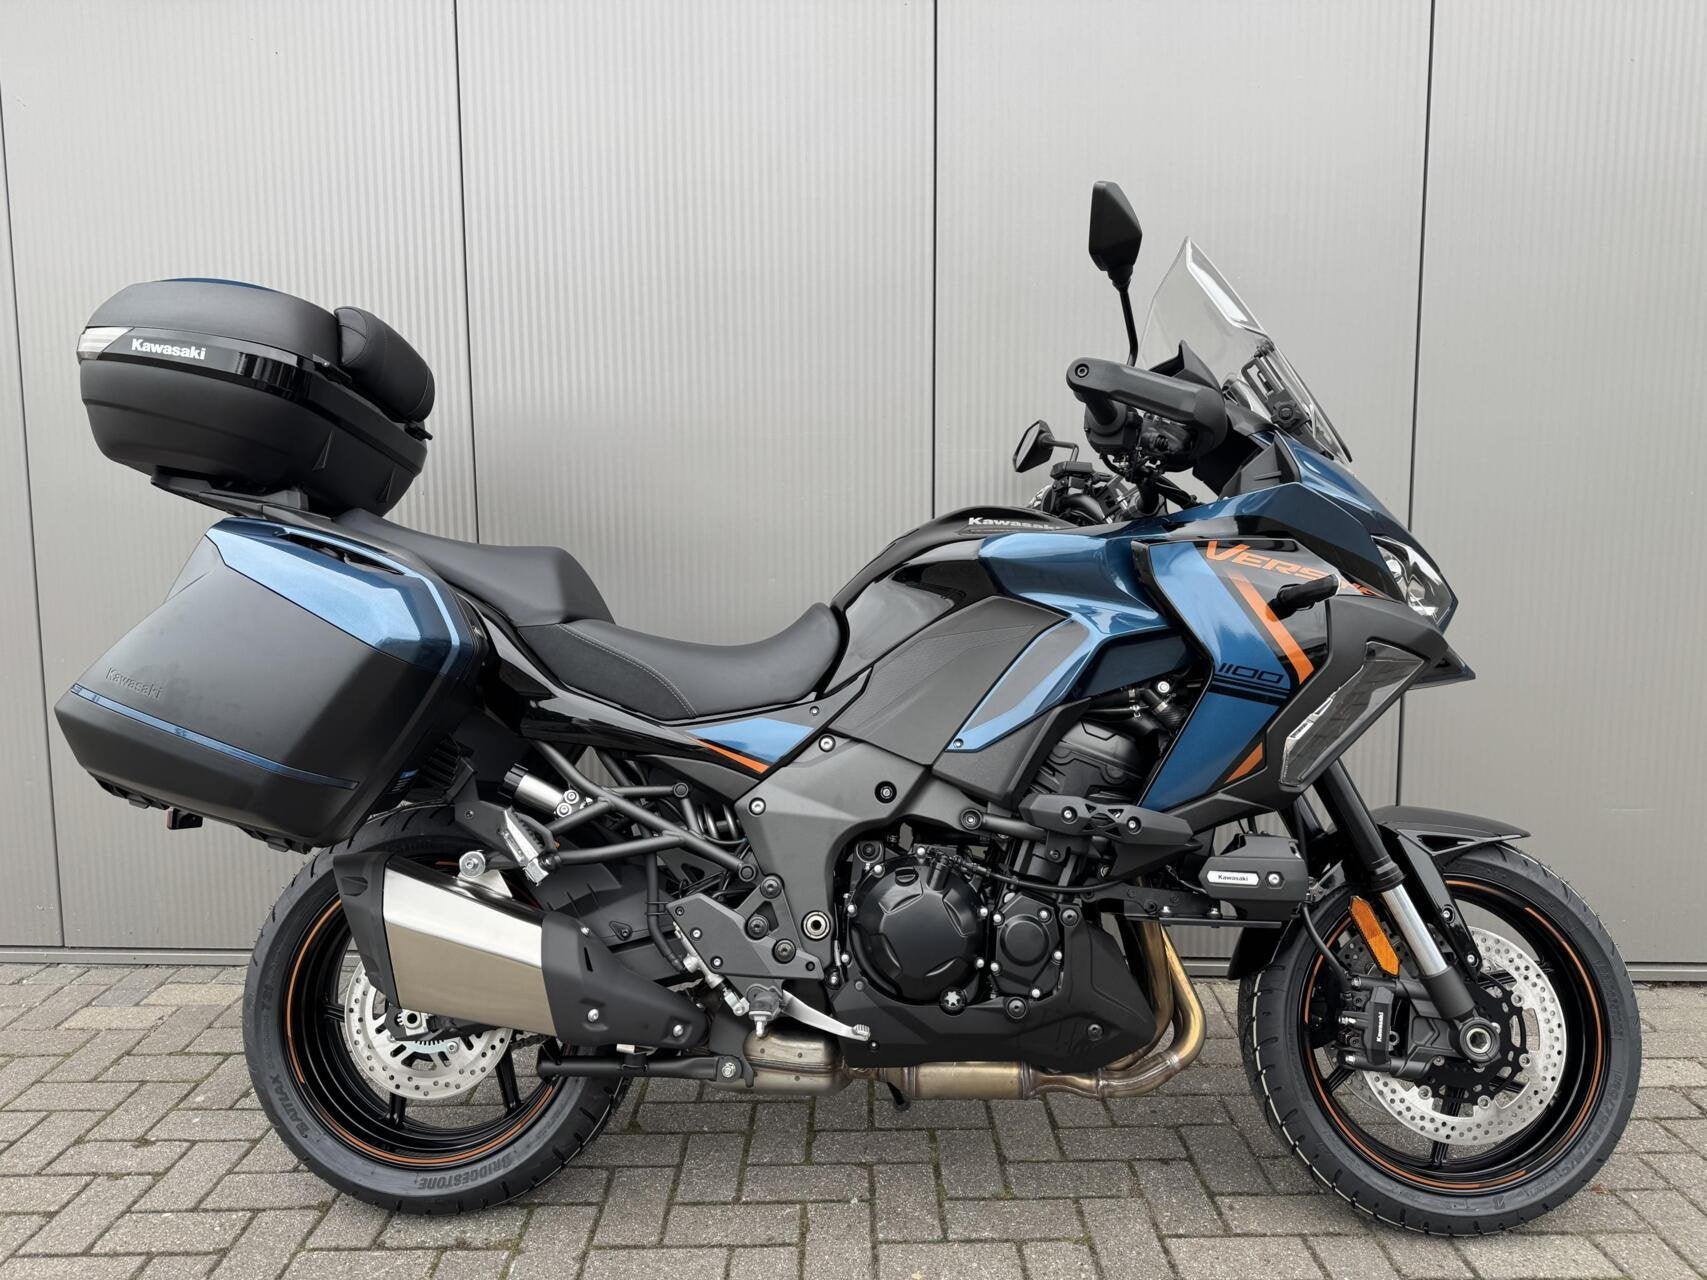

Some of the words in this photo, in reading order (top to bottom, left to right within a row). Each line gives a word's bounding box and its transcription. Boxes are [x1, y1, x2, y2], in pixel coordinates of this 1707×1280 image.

[131, 337, 207, 361] Kawasaki
[105, 666, 164, 699] Kawasaki
[1218, 661, 1286, 685] 1100
[1217, 874, 1249, 882] Kawasaki
[1376, 1011, 1384, 1043] Kawasaki
[418, 1151, 514, 1190] BRIDGESTONE
